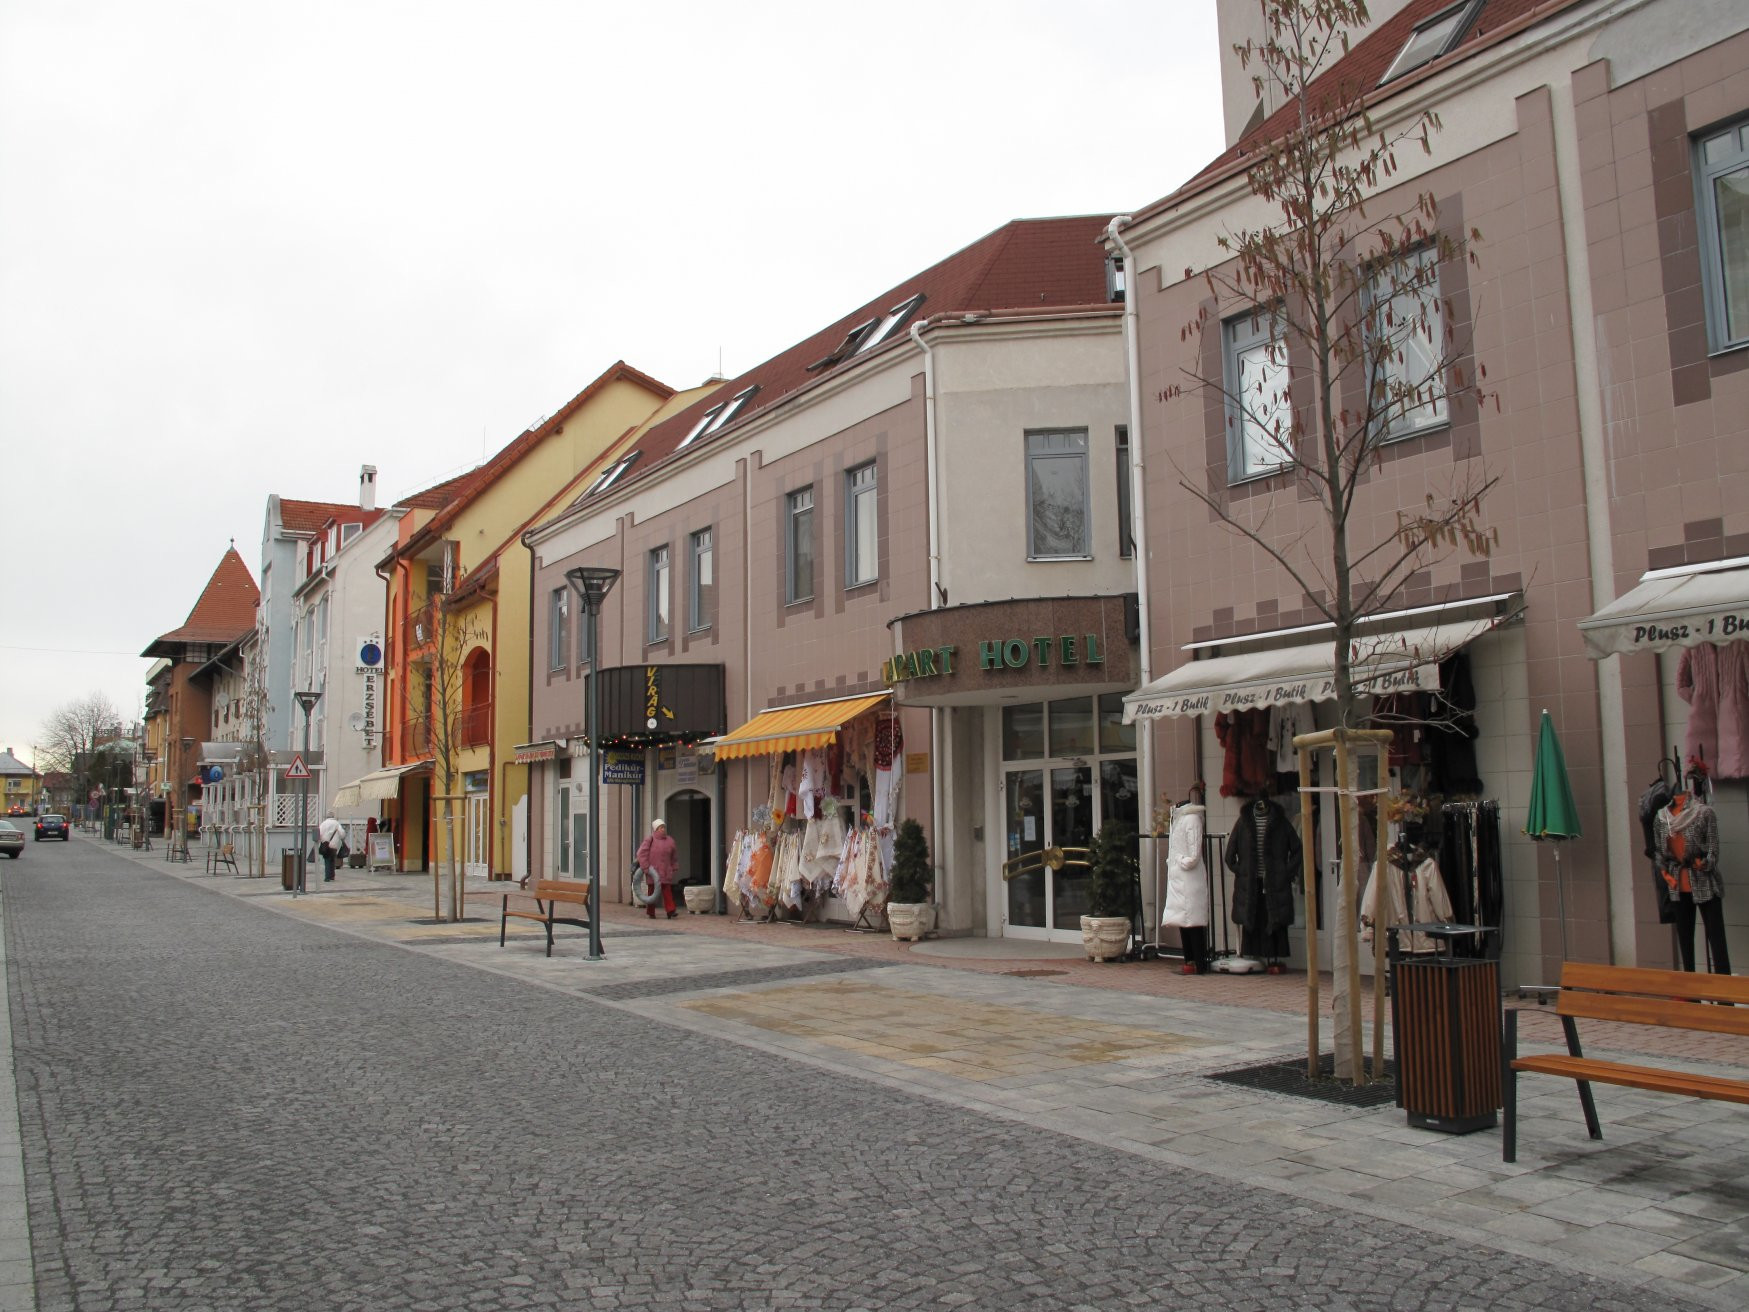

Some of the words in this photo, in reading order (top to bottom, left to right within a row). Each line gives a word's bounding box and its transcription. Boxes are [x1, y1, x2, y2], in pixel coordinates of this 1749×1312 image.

[1634, 625, 1689, 642] Plusz
[1708, 618, 1715, 634] 1
[887, 645, 954, 683] APART
[979, 634, 1104, 669] HOTEL
[647, 666, 658, 717] VIRÁG
[1223, 693, 1256, 706] Plusz
[1274, 684, 1306, 701] Butik
[1135, 703, 1163, 715] Plusz
[1181, 696, 1209, 713] Butik
